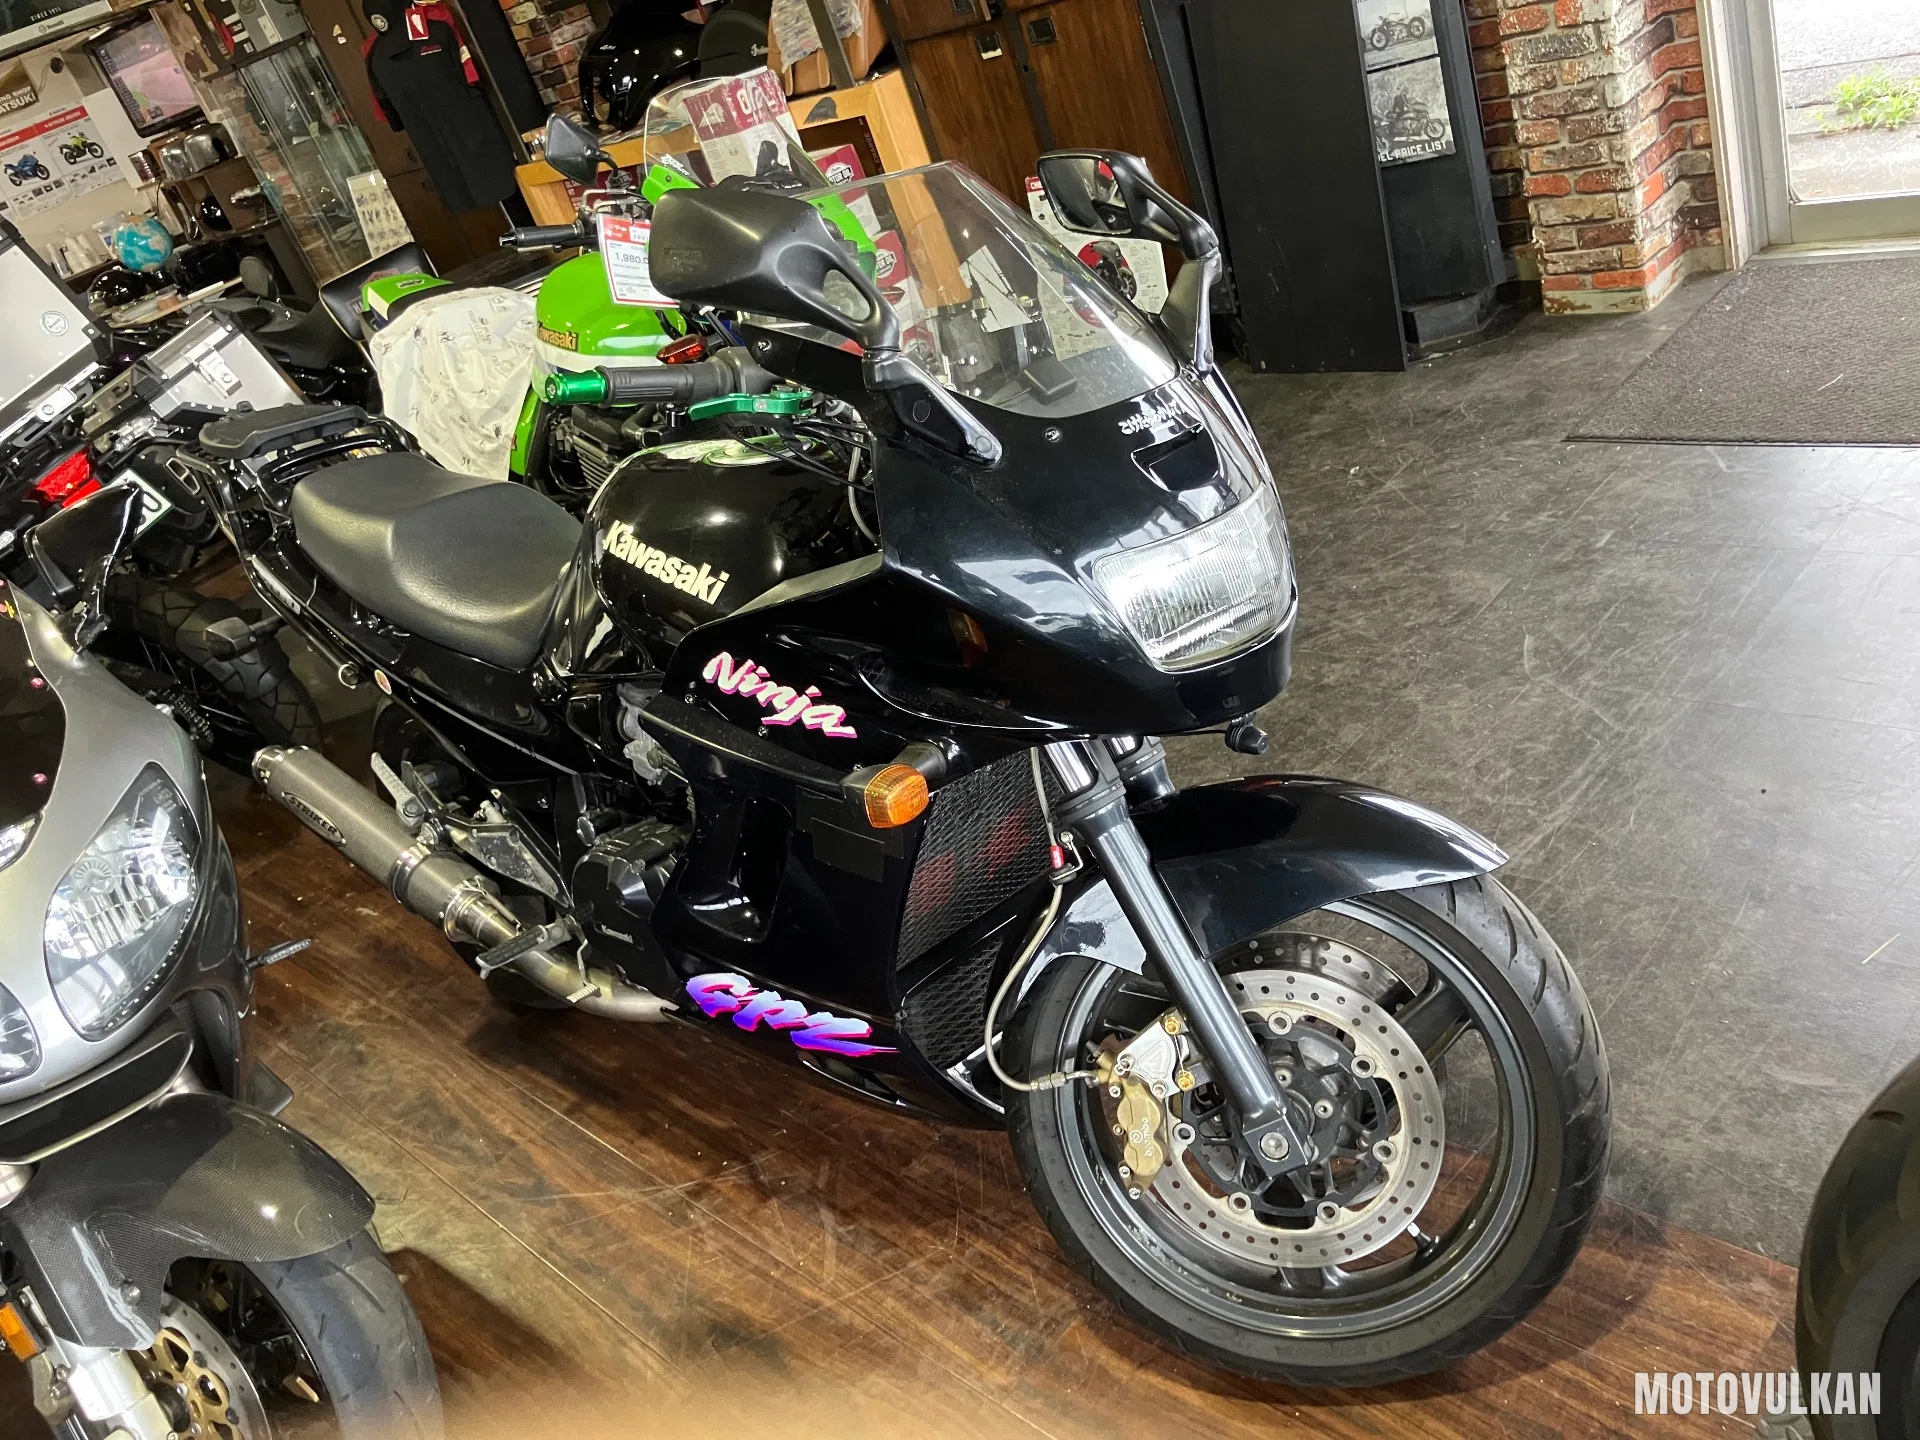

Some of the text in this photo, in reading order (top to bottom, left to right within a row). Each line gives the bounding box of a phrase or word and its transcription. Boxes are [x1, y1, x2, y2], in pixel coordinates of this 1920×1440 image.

[1395, 144, 1424, 159] PRICE
[1425, 140, 1447, 153] LIST
[602, 519, 730, 605] Kawasaki
[702, 651, 858, 739] Ninja
[288, 796, 338, 836] STRIKER
